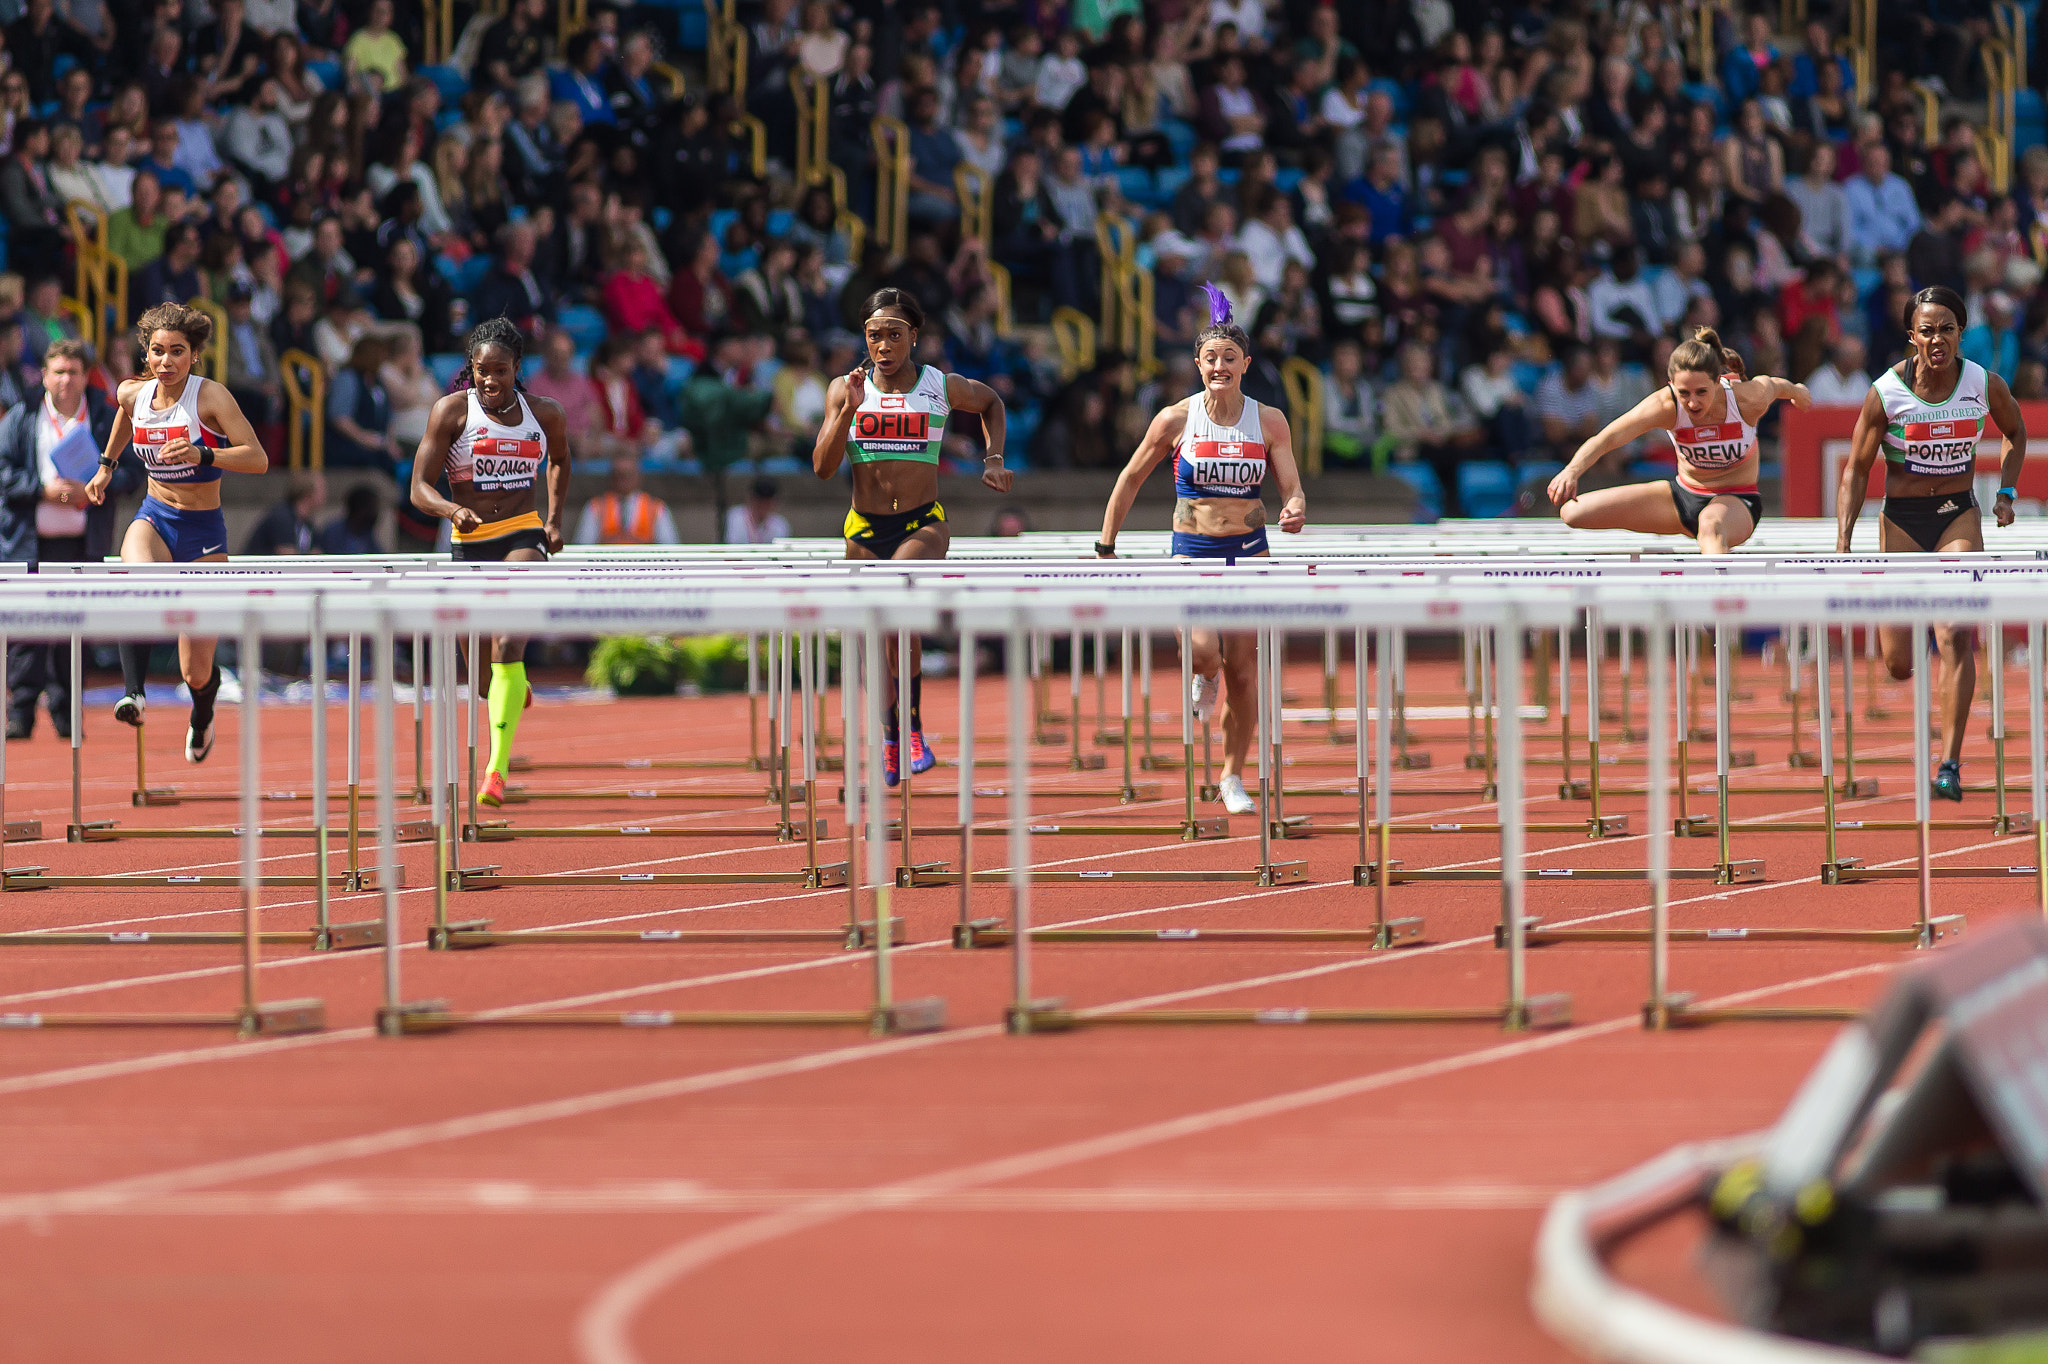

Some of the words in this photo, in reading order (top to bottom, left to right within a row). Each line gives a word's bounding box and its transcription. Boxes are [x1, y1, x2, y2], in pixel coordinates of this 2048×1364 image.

[859, 413, 925, 437] OFILI
[862, 442, 920, 451] BIRMINGHAM
[1679, 442, 1742, 460] DREW
[1908, 441, 1973, 462] PORTER
[1196, 461, 1263, 484] HATTON
[1911, 463, 1966, 475] BIRMINGHAM
[481, 480, 531, 490] BIRMNGHAM
